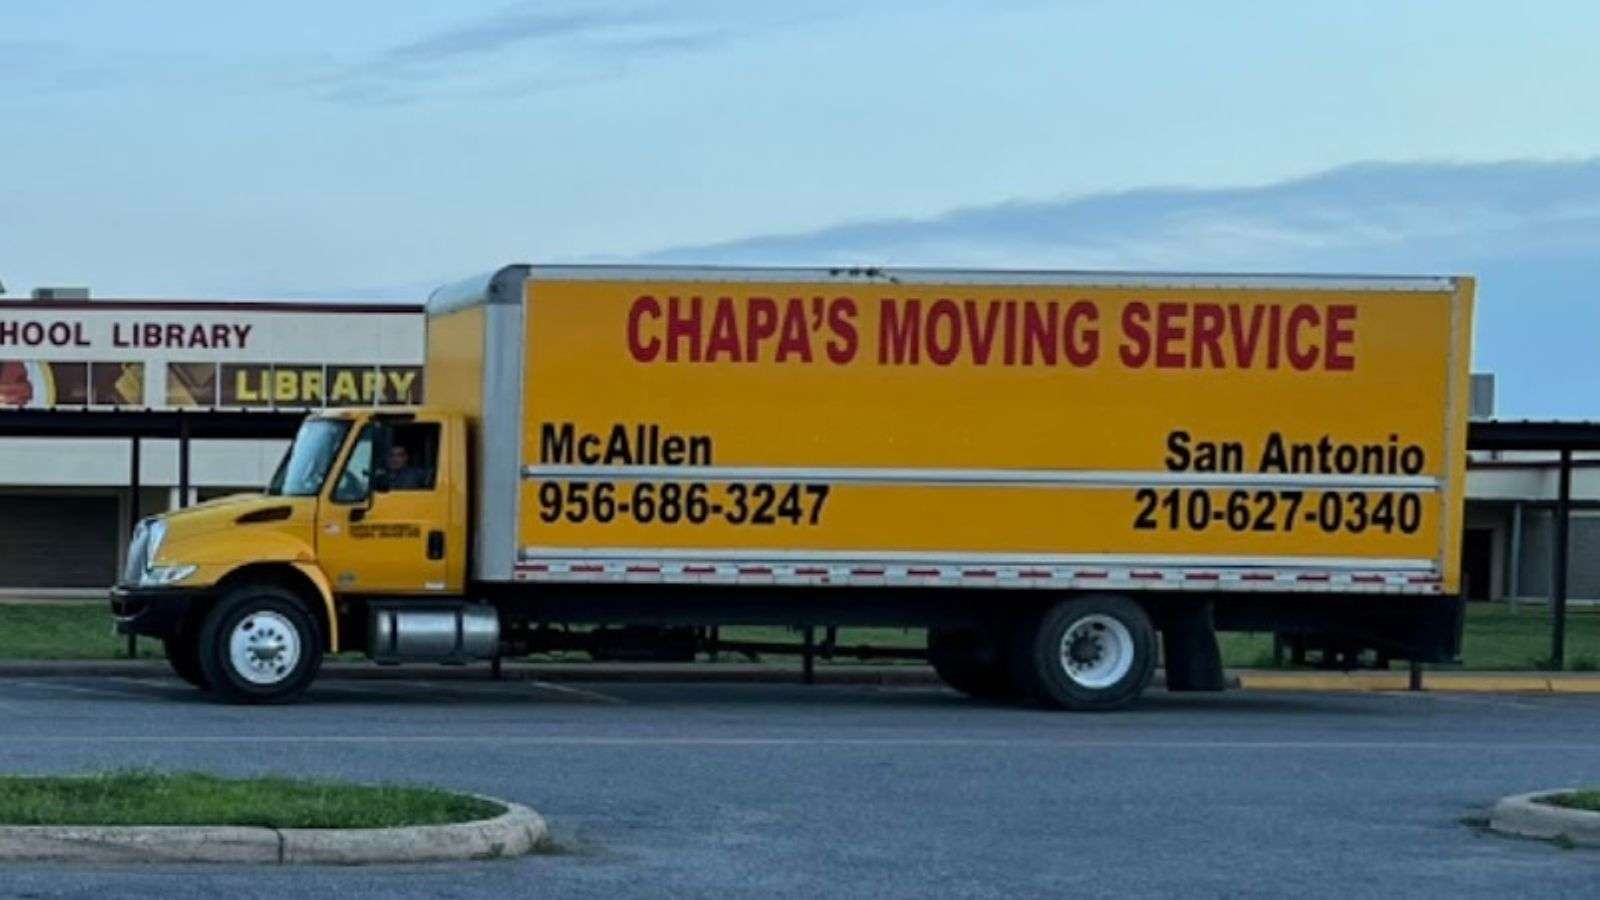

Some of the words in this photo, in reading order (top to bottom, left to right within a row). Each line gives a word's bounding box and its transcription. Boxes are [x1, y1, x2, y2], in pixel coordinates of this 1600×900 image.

[0, 321, 91, 346] HOOL
[112, 323, 252, 349] LIBRARY
[627, 295, 859, 365] CHAPA'S
[878, 298, 1099, 368] MOVING
[1118, 301, 1358, 372] SERVICE
[235, 369, 415, 402] LIBRARY
[540, 422, 713, 466] McAllen
[1165, 430, 1243, 473] San
[1259, 432, 1425, 476] Antonio
[538, 481, 830, 526] 956-686-3247
[1133, 488, 1423, 534] 210-627-0340
